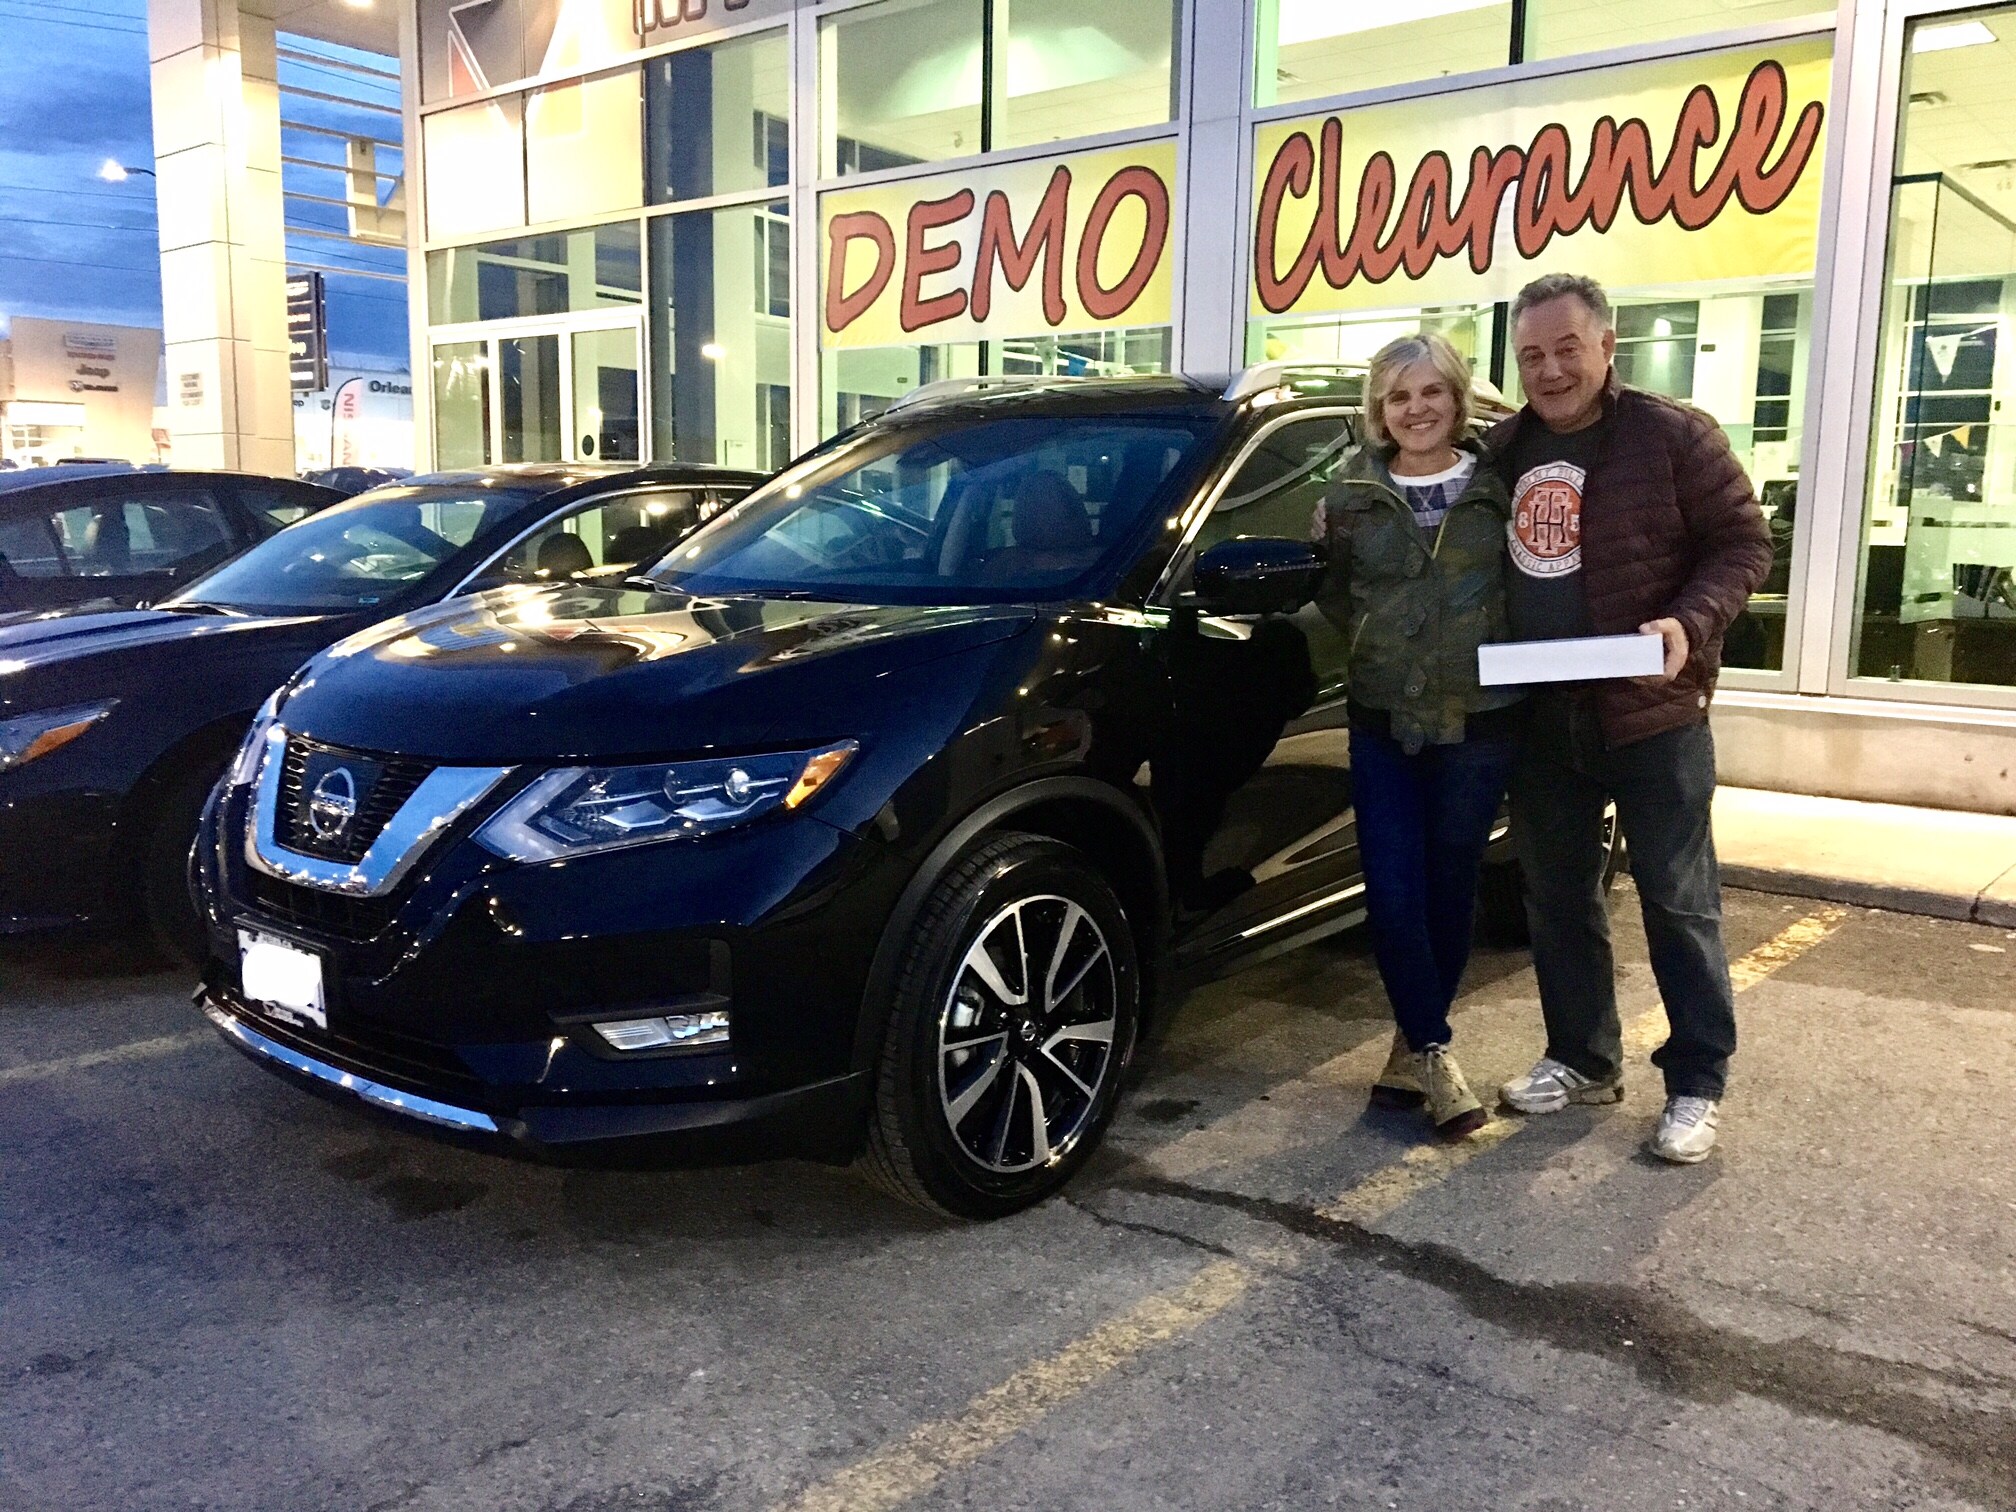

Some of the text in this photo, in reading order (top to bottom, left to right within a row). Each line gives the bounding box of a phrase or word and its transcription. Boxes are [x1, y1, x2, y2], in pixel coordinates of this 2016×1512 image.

[826, 58, 1826, 333] DEMO Clearance
[369, 380, 411, 395] Orlea
